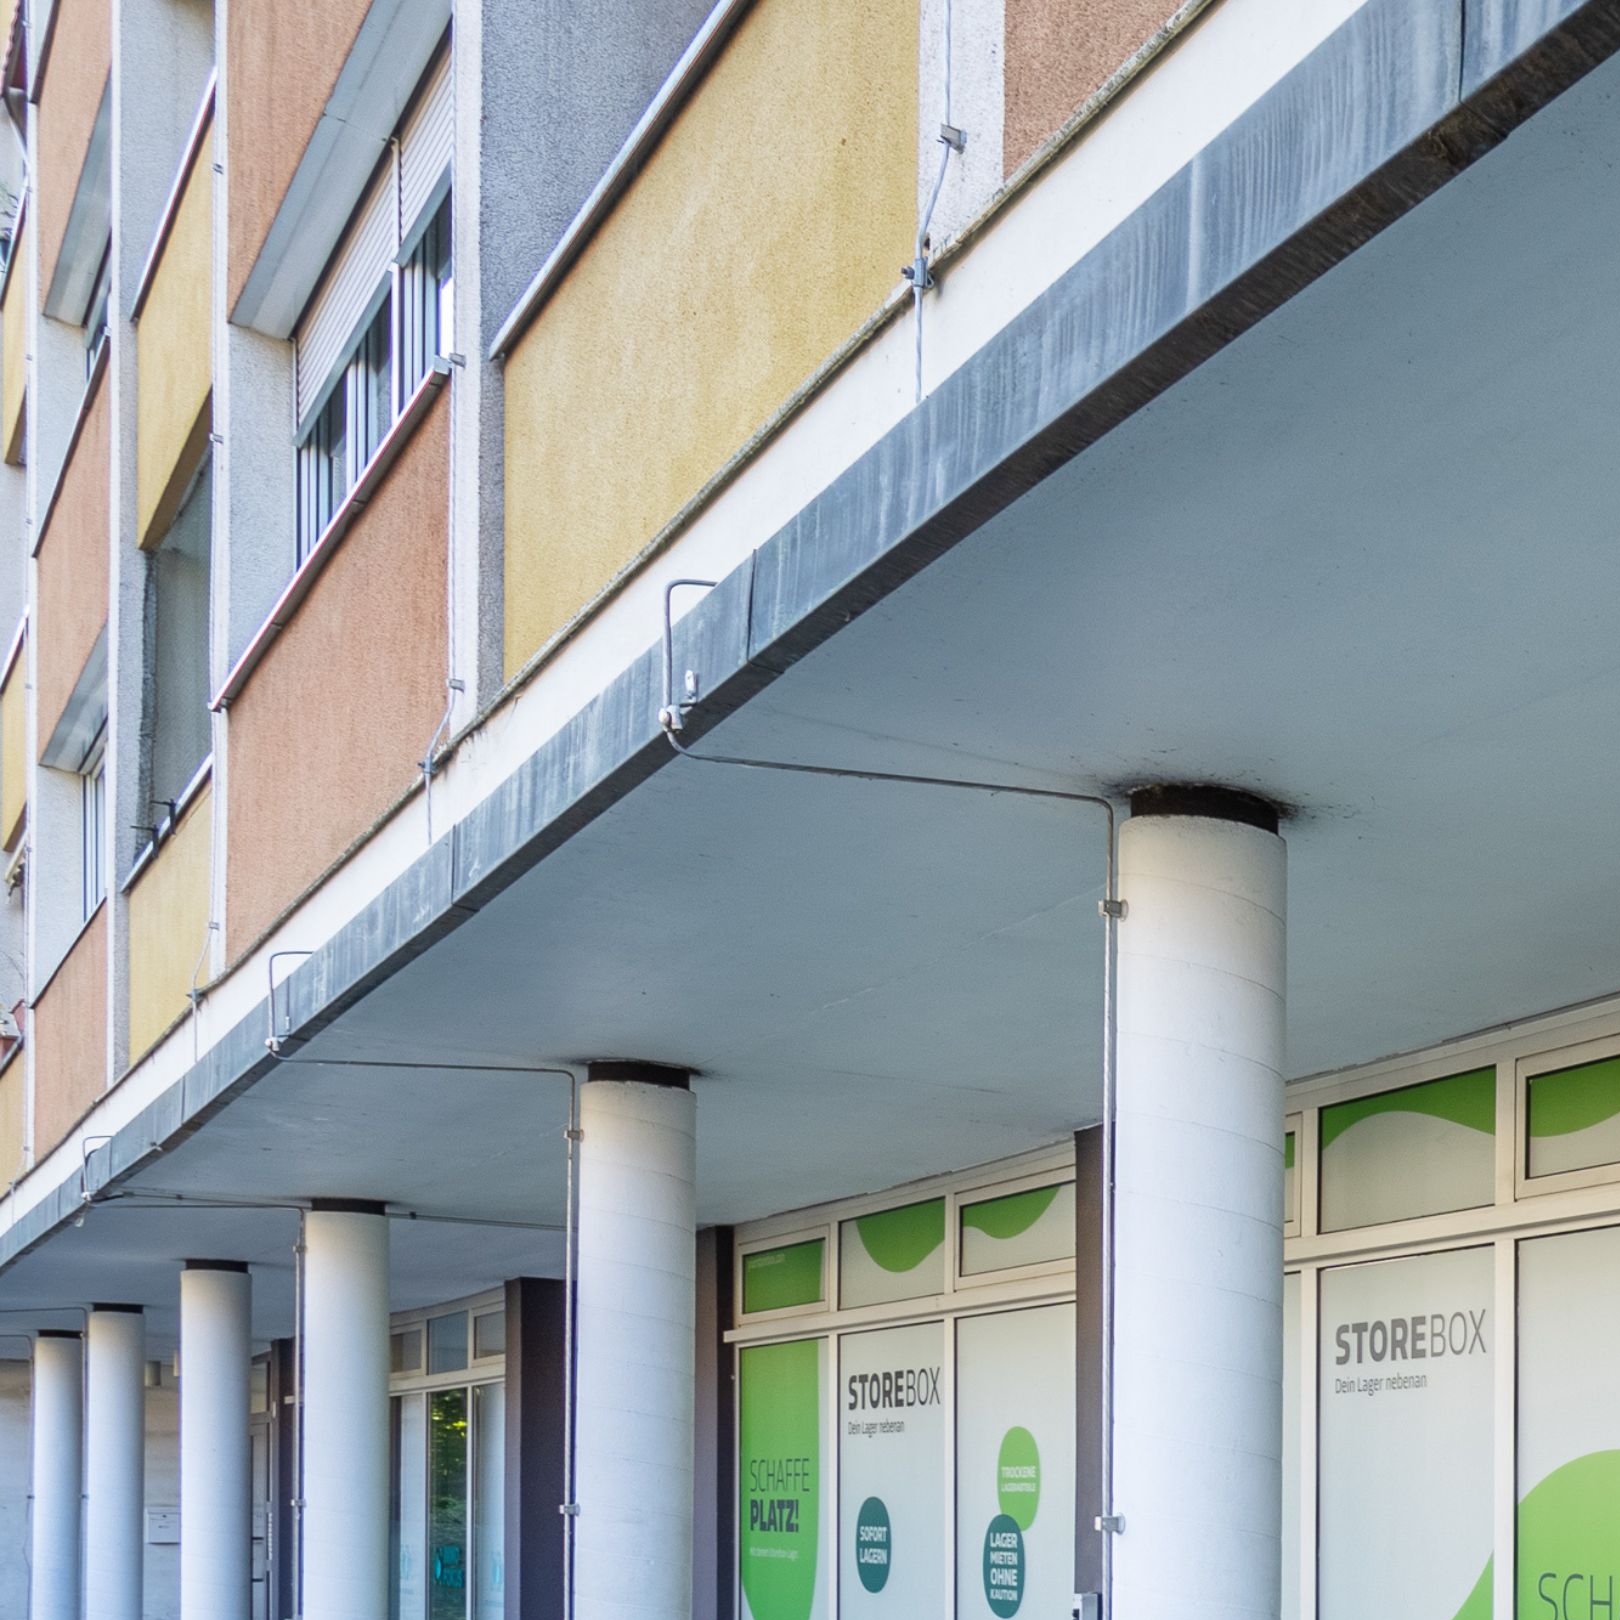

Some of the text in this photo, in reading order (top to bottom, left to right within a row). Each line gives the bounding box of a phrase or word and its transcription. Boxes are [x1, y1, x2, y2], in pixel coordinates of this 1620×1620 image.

[1335, 1308, 1487, 1366] STOREBOX
[848, 1365, 941, 1411] STOREBOX
[1335, 1372, 1428, 1397] Dein Lager nebenan
[750, 1457, 811, 1493] SCHAFFE
[750, 1498, 799, 1533] PLATZ!
[859, 1525, 888, 1542] SOFORT
[989, 1531, 1018, 1549] LAGER
[859, 1547, 888, 1565] LAGERN
[989, 1550, 1018, 1566] MIETEN
[989, 1567, 1018, 1587] OHNE
